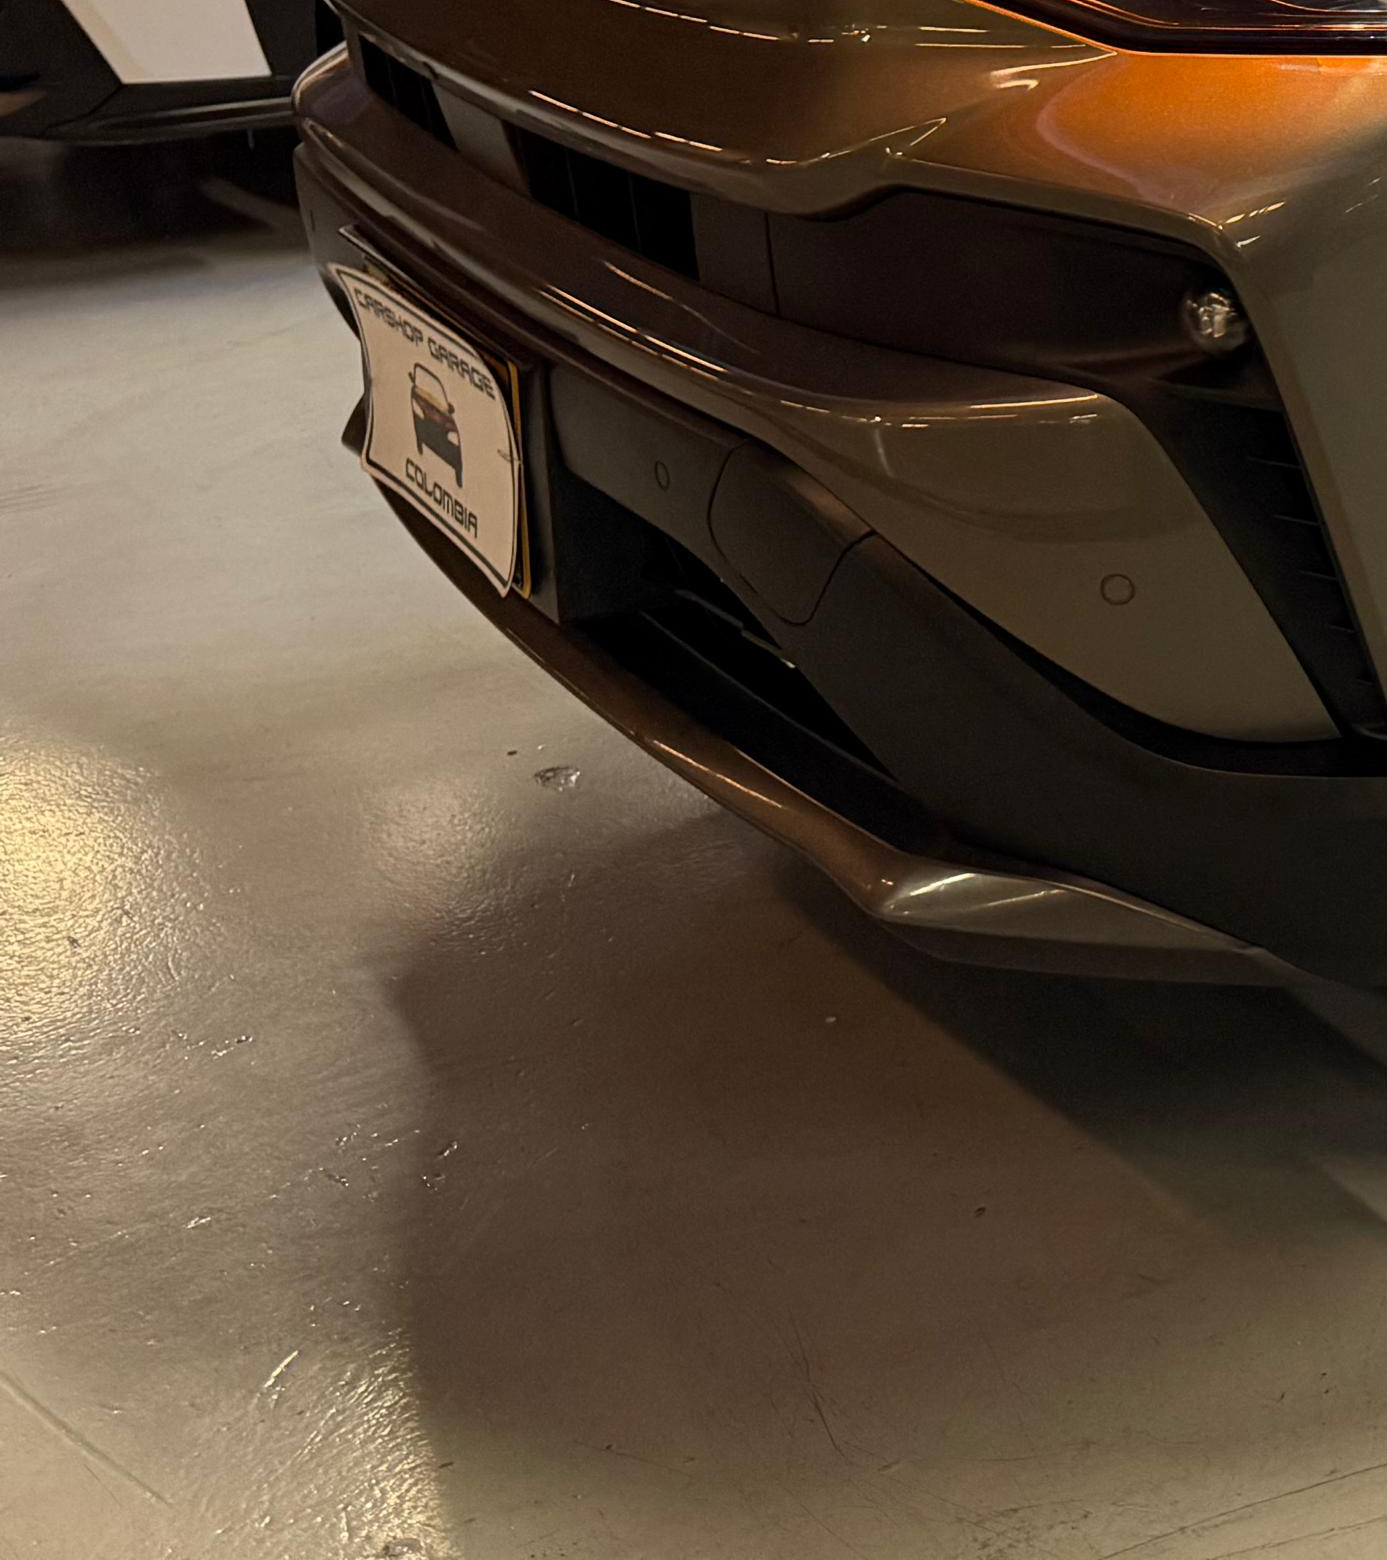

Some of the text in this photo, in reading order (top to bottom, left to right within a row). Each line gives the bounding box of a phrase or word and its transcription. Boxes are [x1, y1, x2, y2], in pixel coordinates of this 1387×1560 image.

[355, 288, 496, 401] CARSHOP GARAGE
[405, 457, 478, 540] COLOMBIA
